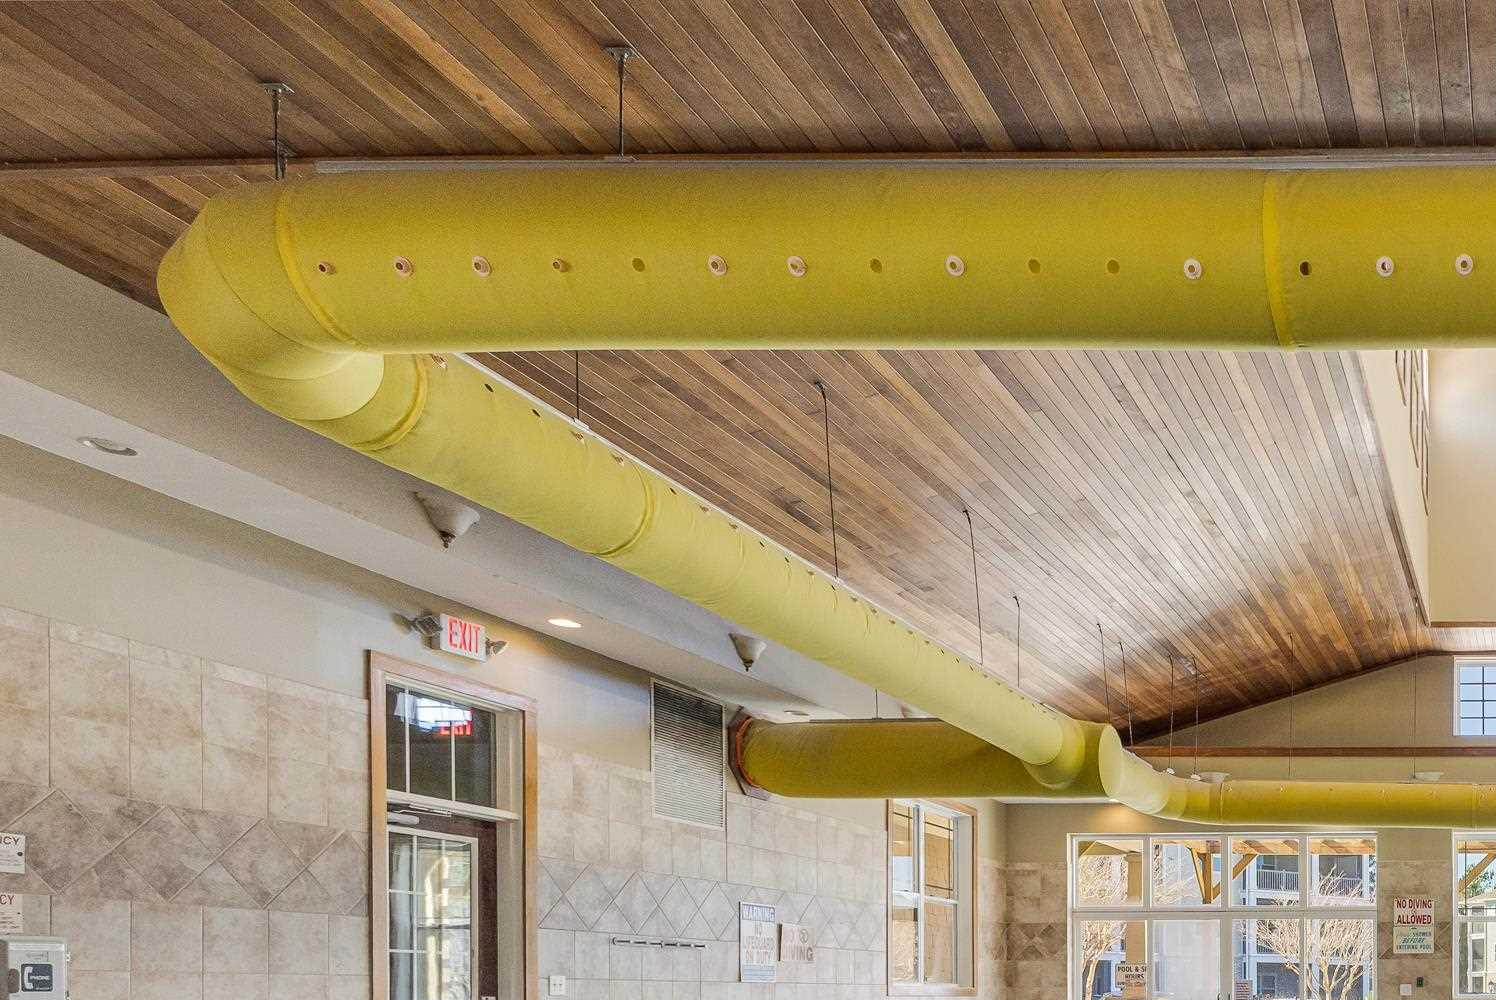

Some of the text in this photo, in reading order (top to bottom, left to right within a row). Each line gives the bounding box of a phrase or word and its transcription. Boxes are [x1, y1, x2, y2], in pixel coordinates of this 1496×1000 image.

[447, 616, 481, 654] EXIT
[1396, 899, 1432, 909] NO DIVING
[1397, 914, 1432, 925] ALLOWED
[1117, 965, 1133, 973] POOL
